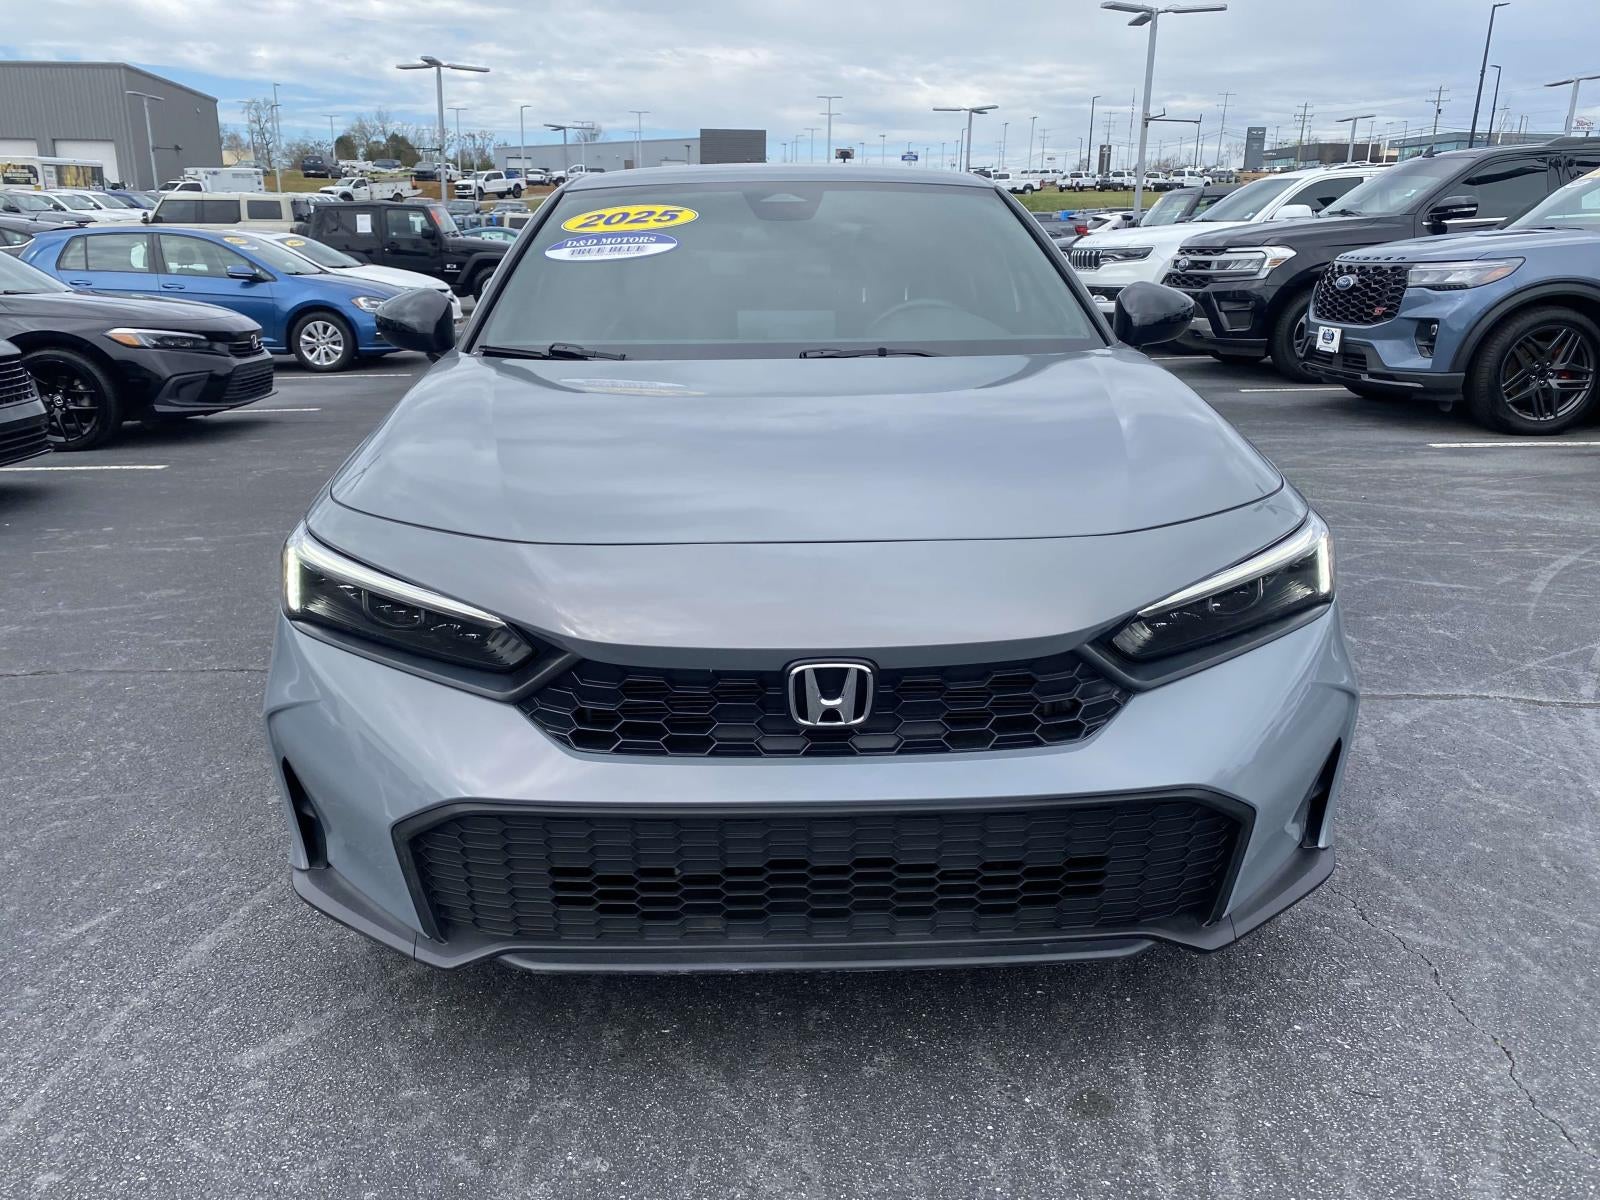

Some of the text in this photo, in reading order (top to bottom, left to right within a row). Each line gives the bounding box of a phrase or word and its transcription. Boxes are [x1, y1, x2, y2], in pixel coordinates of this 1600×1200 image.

[576, 210, 684, 229] 2025
[566, 236, 657, 248] D&D MOTORS
[569, 246, 606, 256] TRUE
[608, 244, 647, 253] BLUE
